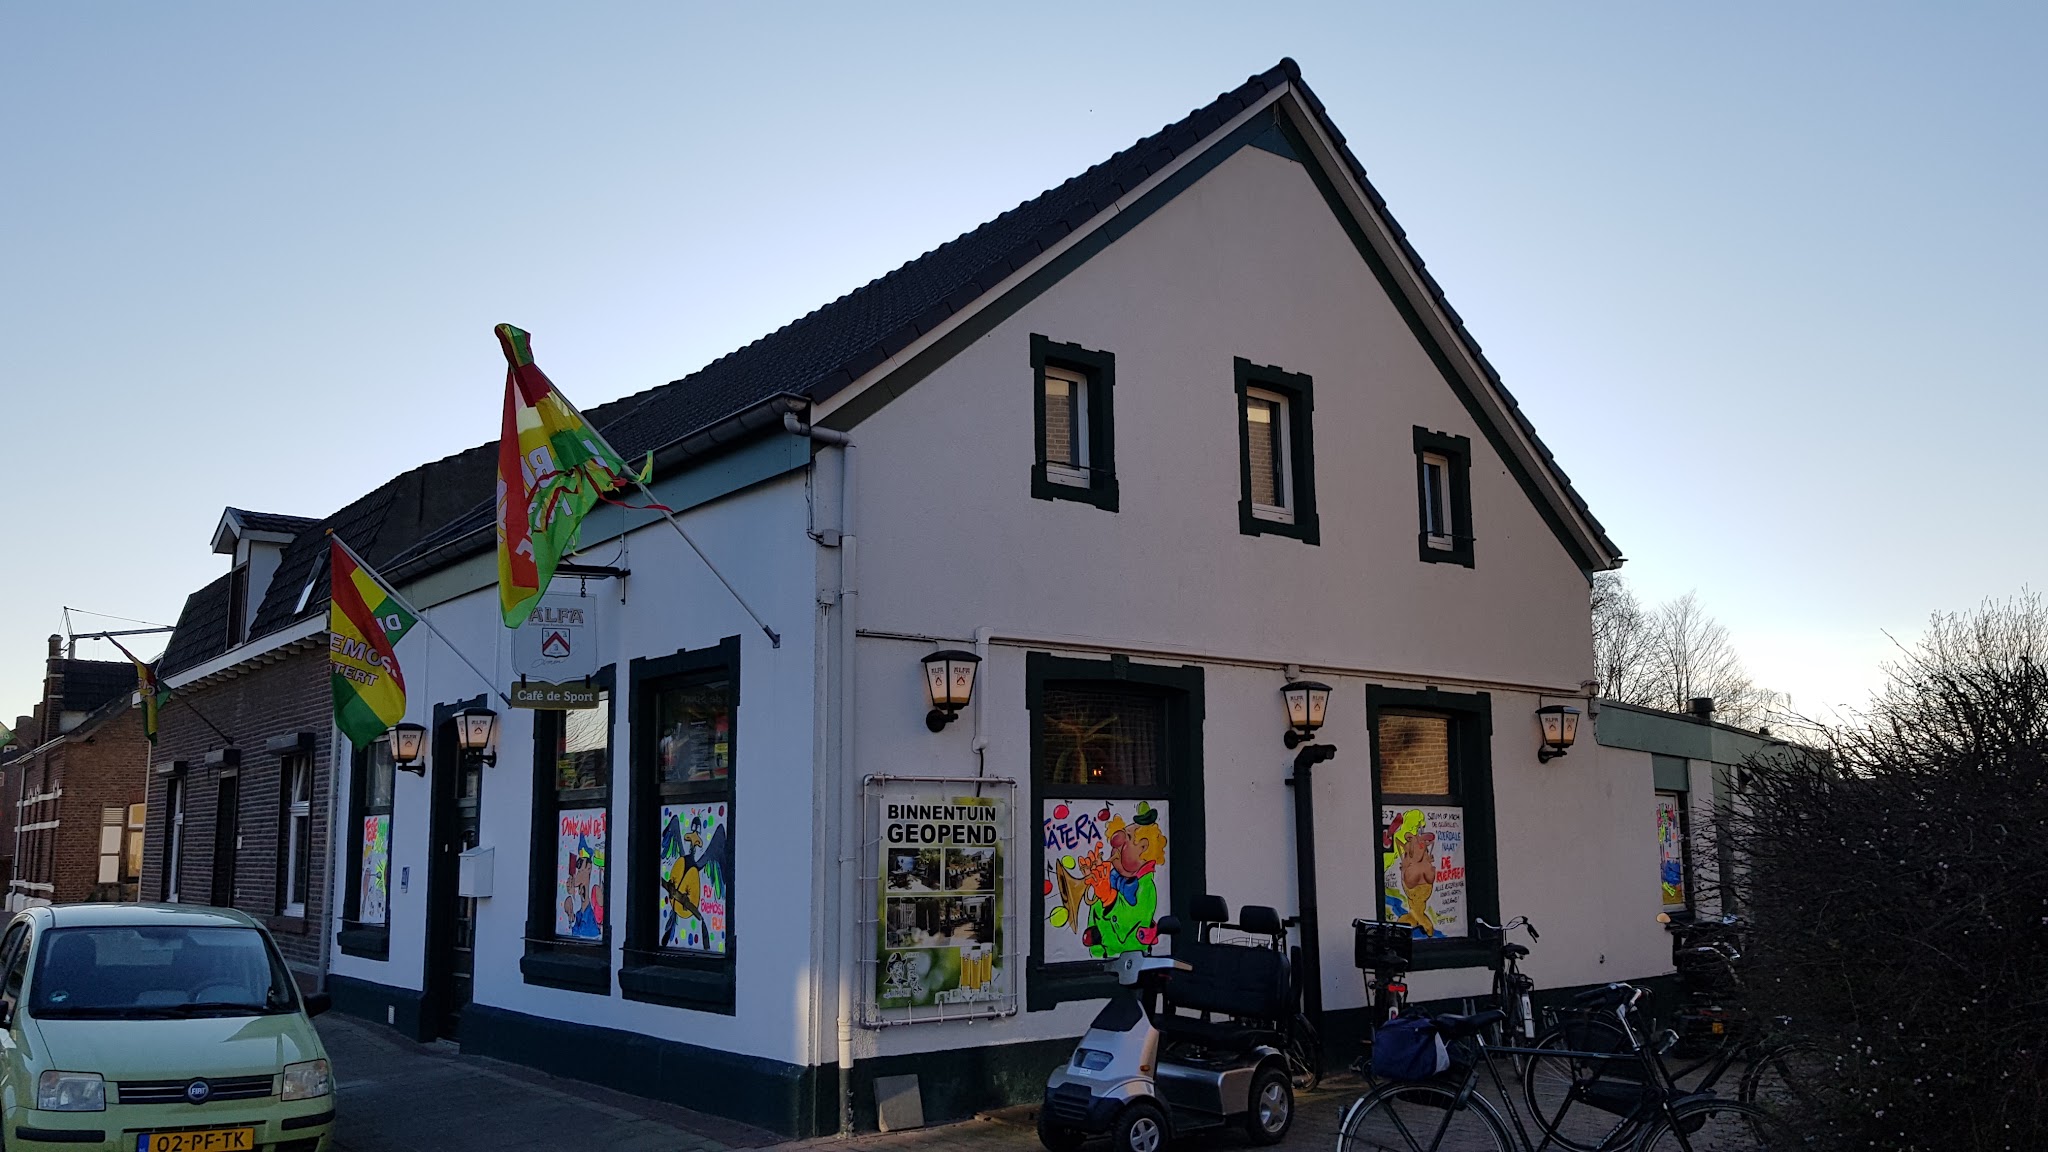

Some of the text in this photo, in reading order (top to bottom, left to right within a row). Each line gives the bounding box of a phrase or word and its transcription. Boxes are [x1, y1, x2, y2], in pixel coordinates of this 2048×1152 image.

[528, 607, 584, 624] ALFA
[329, 659, 379, 686] TERT
[517, 690, 594, 703] Café de Sport
[888, 805, 996, 821] BINNENTUIN
[888, 824, 996, 844] GEOPEND
[191, 1087, 206, 1095] FIAT
[157, 1132, 245, 1152] 02-PF-TK
